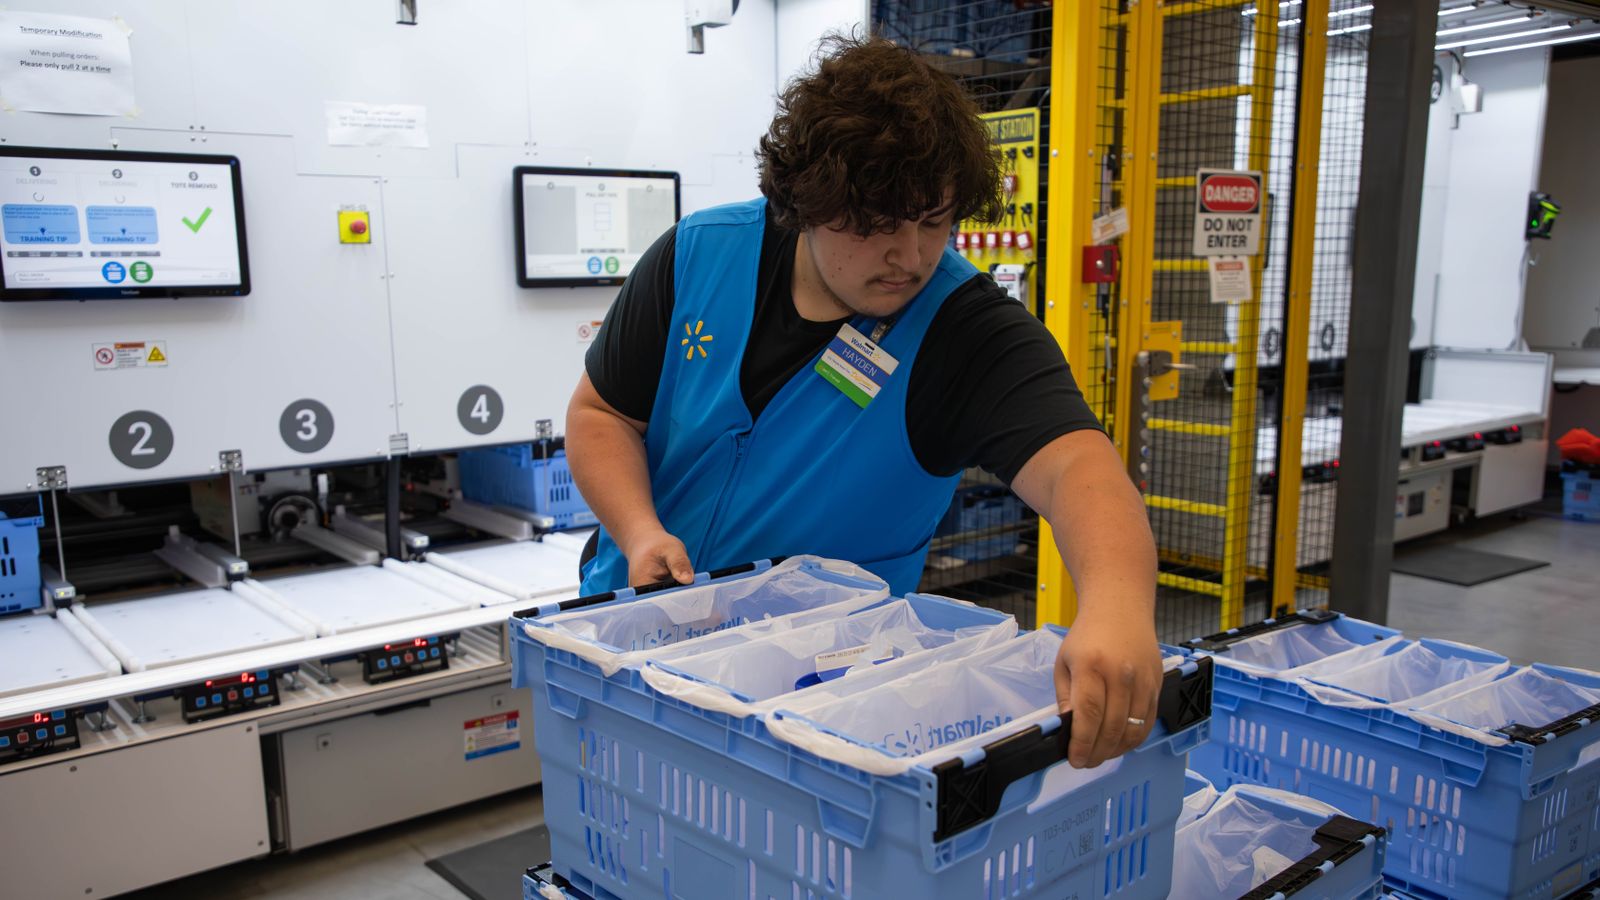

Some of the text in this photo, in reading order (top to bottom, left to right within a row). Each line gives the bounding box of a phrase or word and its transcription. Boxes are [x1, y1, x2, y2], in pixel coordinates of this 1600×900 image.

[20, 26, 103, 39] Temporary Modification
[30, 49, 50, 58] When
[52, 51, 75, 61] pulling
[20, 60, 43, 69] Please
[44, 62, 60, 71] only
[61, 63, 75, 73] pull
[75, 64, 80, 72] 2
[96, 65, 111, 73] time
[1205, 185, 1255, 203] DANGER
[1203, 218, 1253, 232] DO NOT
[1207, 235, 1248, 248] ENTER
[850, 337, 873, 357] Walmart
[842, 347, 877, 377] HAYDEN
[470, 394, 490, 424] 4
[295, 409, 318, 441] 3
[128, 421, 156, 456] 2
[34, 712, 42, 723] 0
